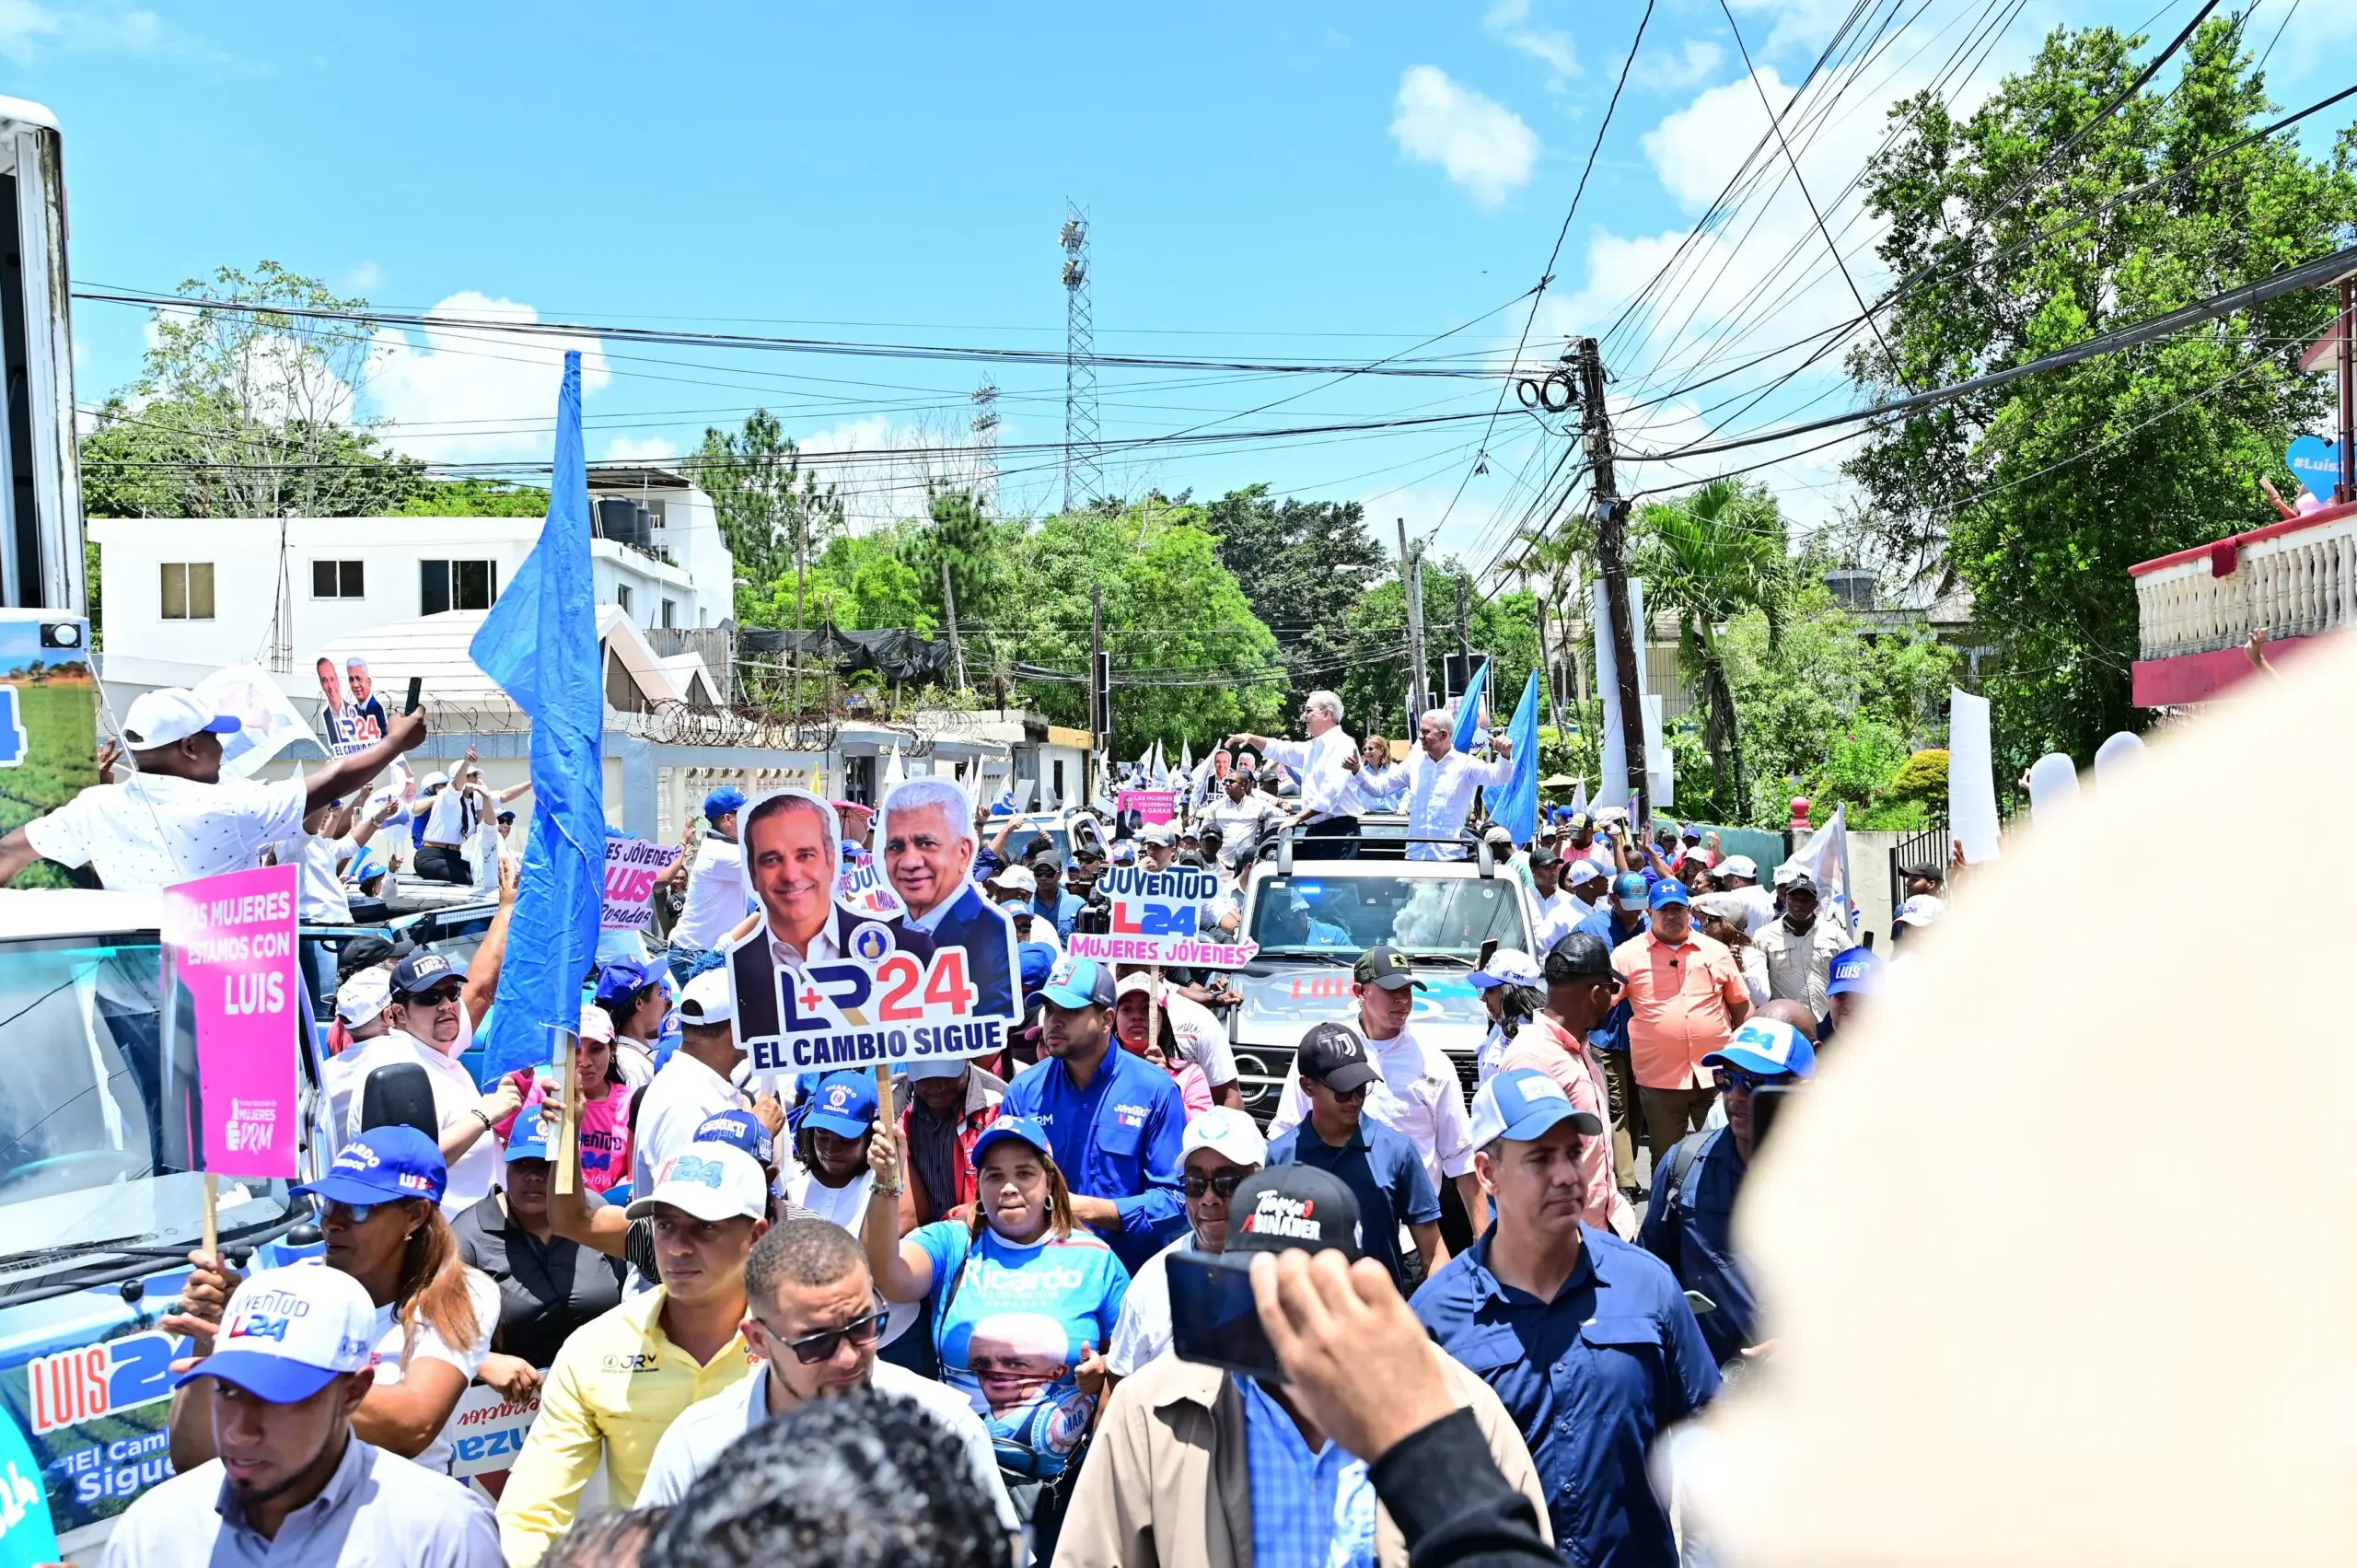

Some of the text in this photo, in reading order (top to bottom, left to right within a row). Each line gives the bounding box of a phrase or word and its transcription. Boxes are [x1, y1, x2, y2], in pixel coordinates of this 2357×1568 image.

[605, 866, 656, 902] LUIS
[211, 890, 291, 927] MUJERES
[188, 931, 291, 966] ESTAMOS CON
[1071, 935, 1159, 961] MUJERES
[1836, 965, 1862, 979] LUIS
[225, 971, 285, 1016] LUIS
[753, 1021, 1002, 1070] EL CAMBIO SIGUE
[825, 1085, 858, 1098] RICARDO
[238, 1109, 276, 1121] MUJERES
[822, 1105, 850, 1115] SENADOR
[960, 1258, 1084, 1292] Ricardo
[621, 1349, 660, 1369] JRM
[1062, 1410, 1085, 1435] MAR
[67, 1447, 100, 1474] ¡El
